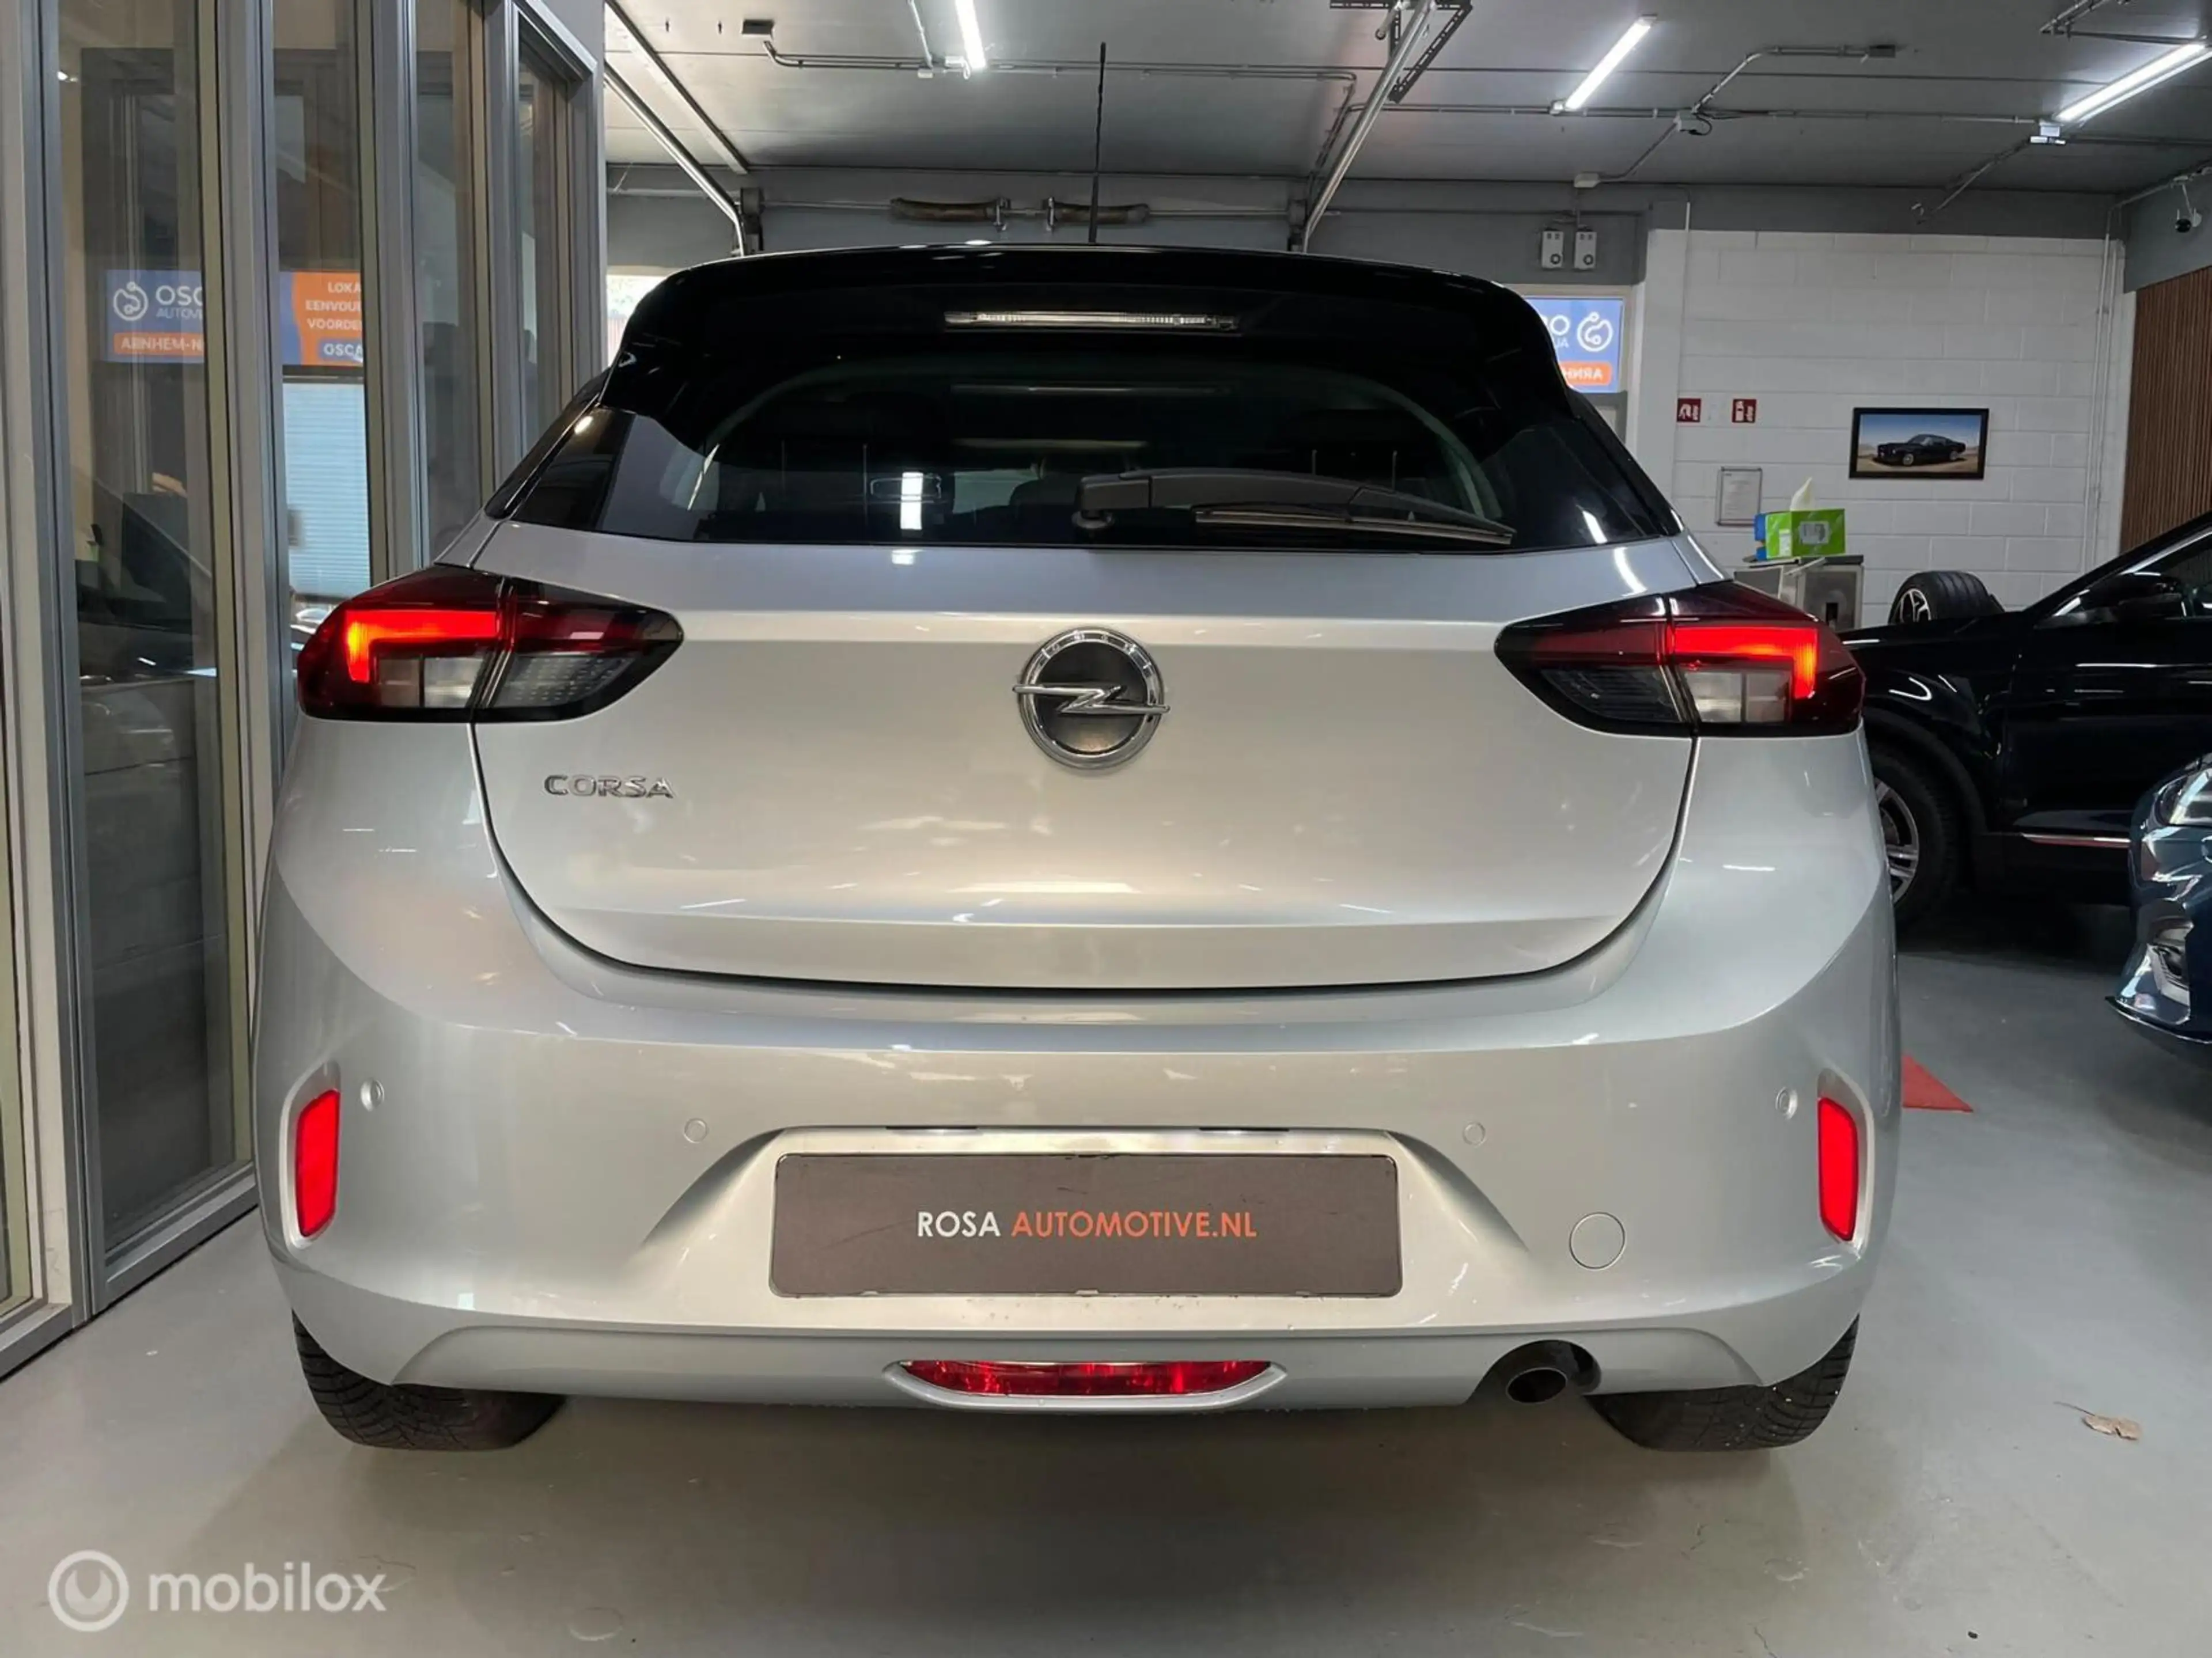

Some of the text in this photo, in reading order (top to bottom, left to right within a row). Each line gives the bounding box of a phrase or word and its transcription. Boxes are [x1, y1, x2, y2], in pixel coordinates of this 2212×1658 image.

[544, 775, 674, 799] CORSA
[918, 1211, 1257, 1238] ROSA AUTOMOTIVE.NL
